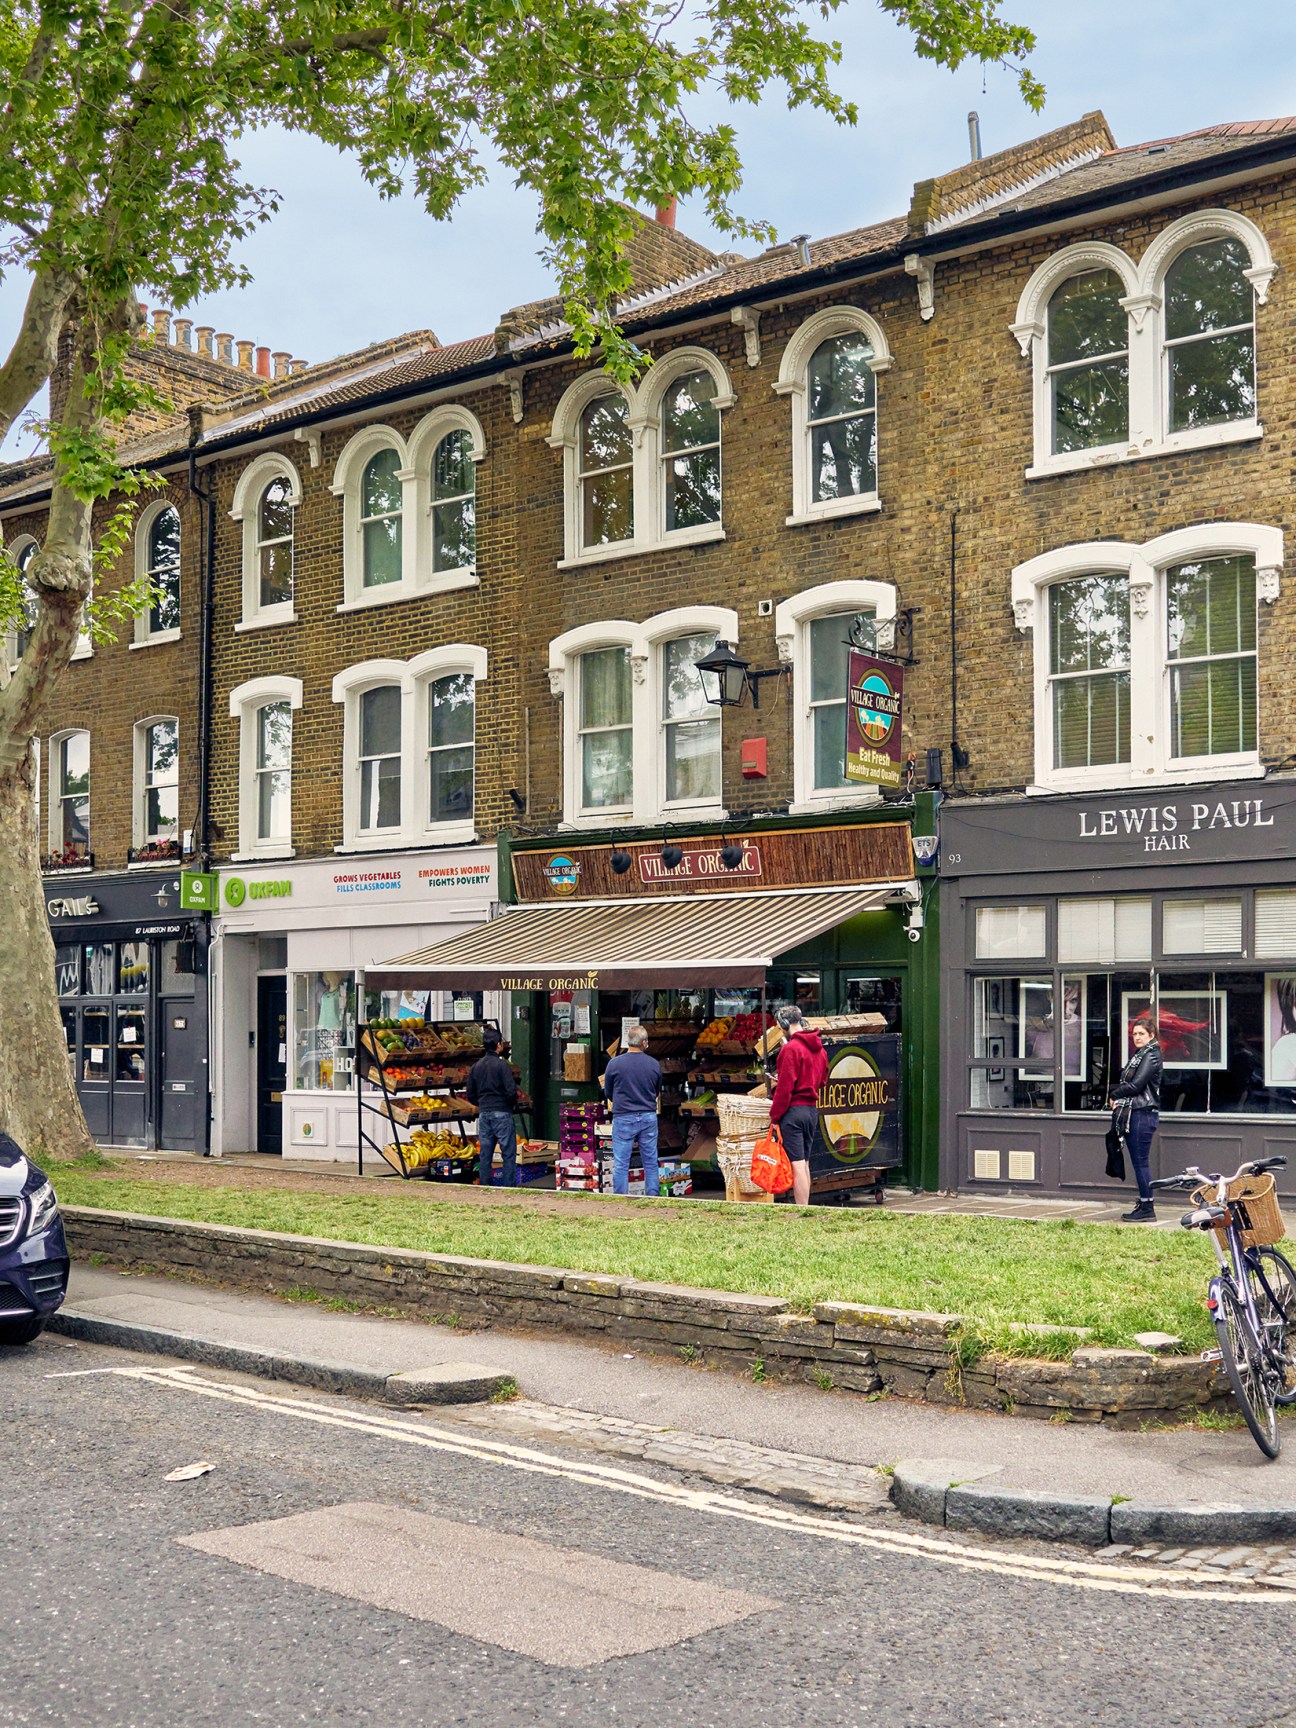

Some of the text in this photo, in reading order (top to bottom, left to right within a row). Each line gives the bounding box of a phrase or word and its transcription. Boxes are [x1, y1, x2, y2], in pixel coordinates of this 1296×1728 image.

[851, 689, 900, 714] VILLAGE ORGANIC
[859, 746, 890, 766] Eat Fresh
[848, 761, 899, 783] Healthy and Quality
[1079, 799, 1274, 837] LEWIS PAUL
[917, 839, 932, 848] ETS
[1143, 834, 1191, 852] HAIR
[697, 850, 755, 875] ORGIC
[948, 854, 962, 865] 93
[333, 871, 402, 884] GROWS VEGETABLES
[418, 865, 491, 878] EMPOWERS WOMEN
[336, 881, 402, 893] FILLS CLASSROOMS
[428, 875, 490, 888] FIGHTS POVERTY
[249, 880, 292, 899] OXFAM
[189, 896, 206, 904] OXFAM
[166, 925, 181, 933] ROAD
[500, 977, 599, 990] VILLAGE ORGANIC
[816, 1080, 888, 1108] LLAGE ORGANIC
